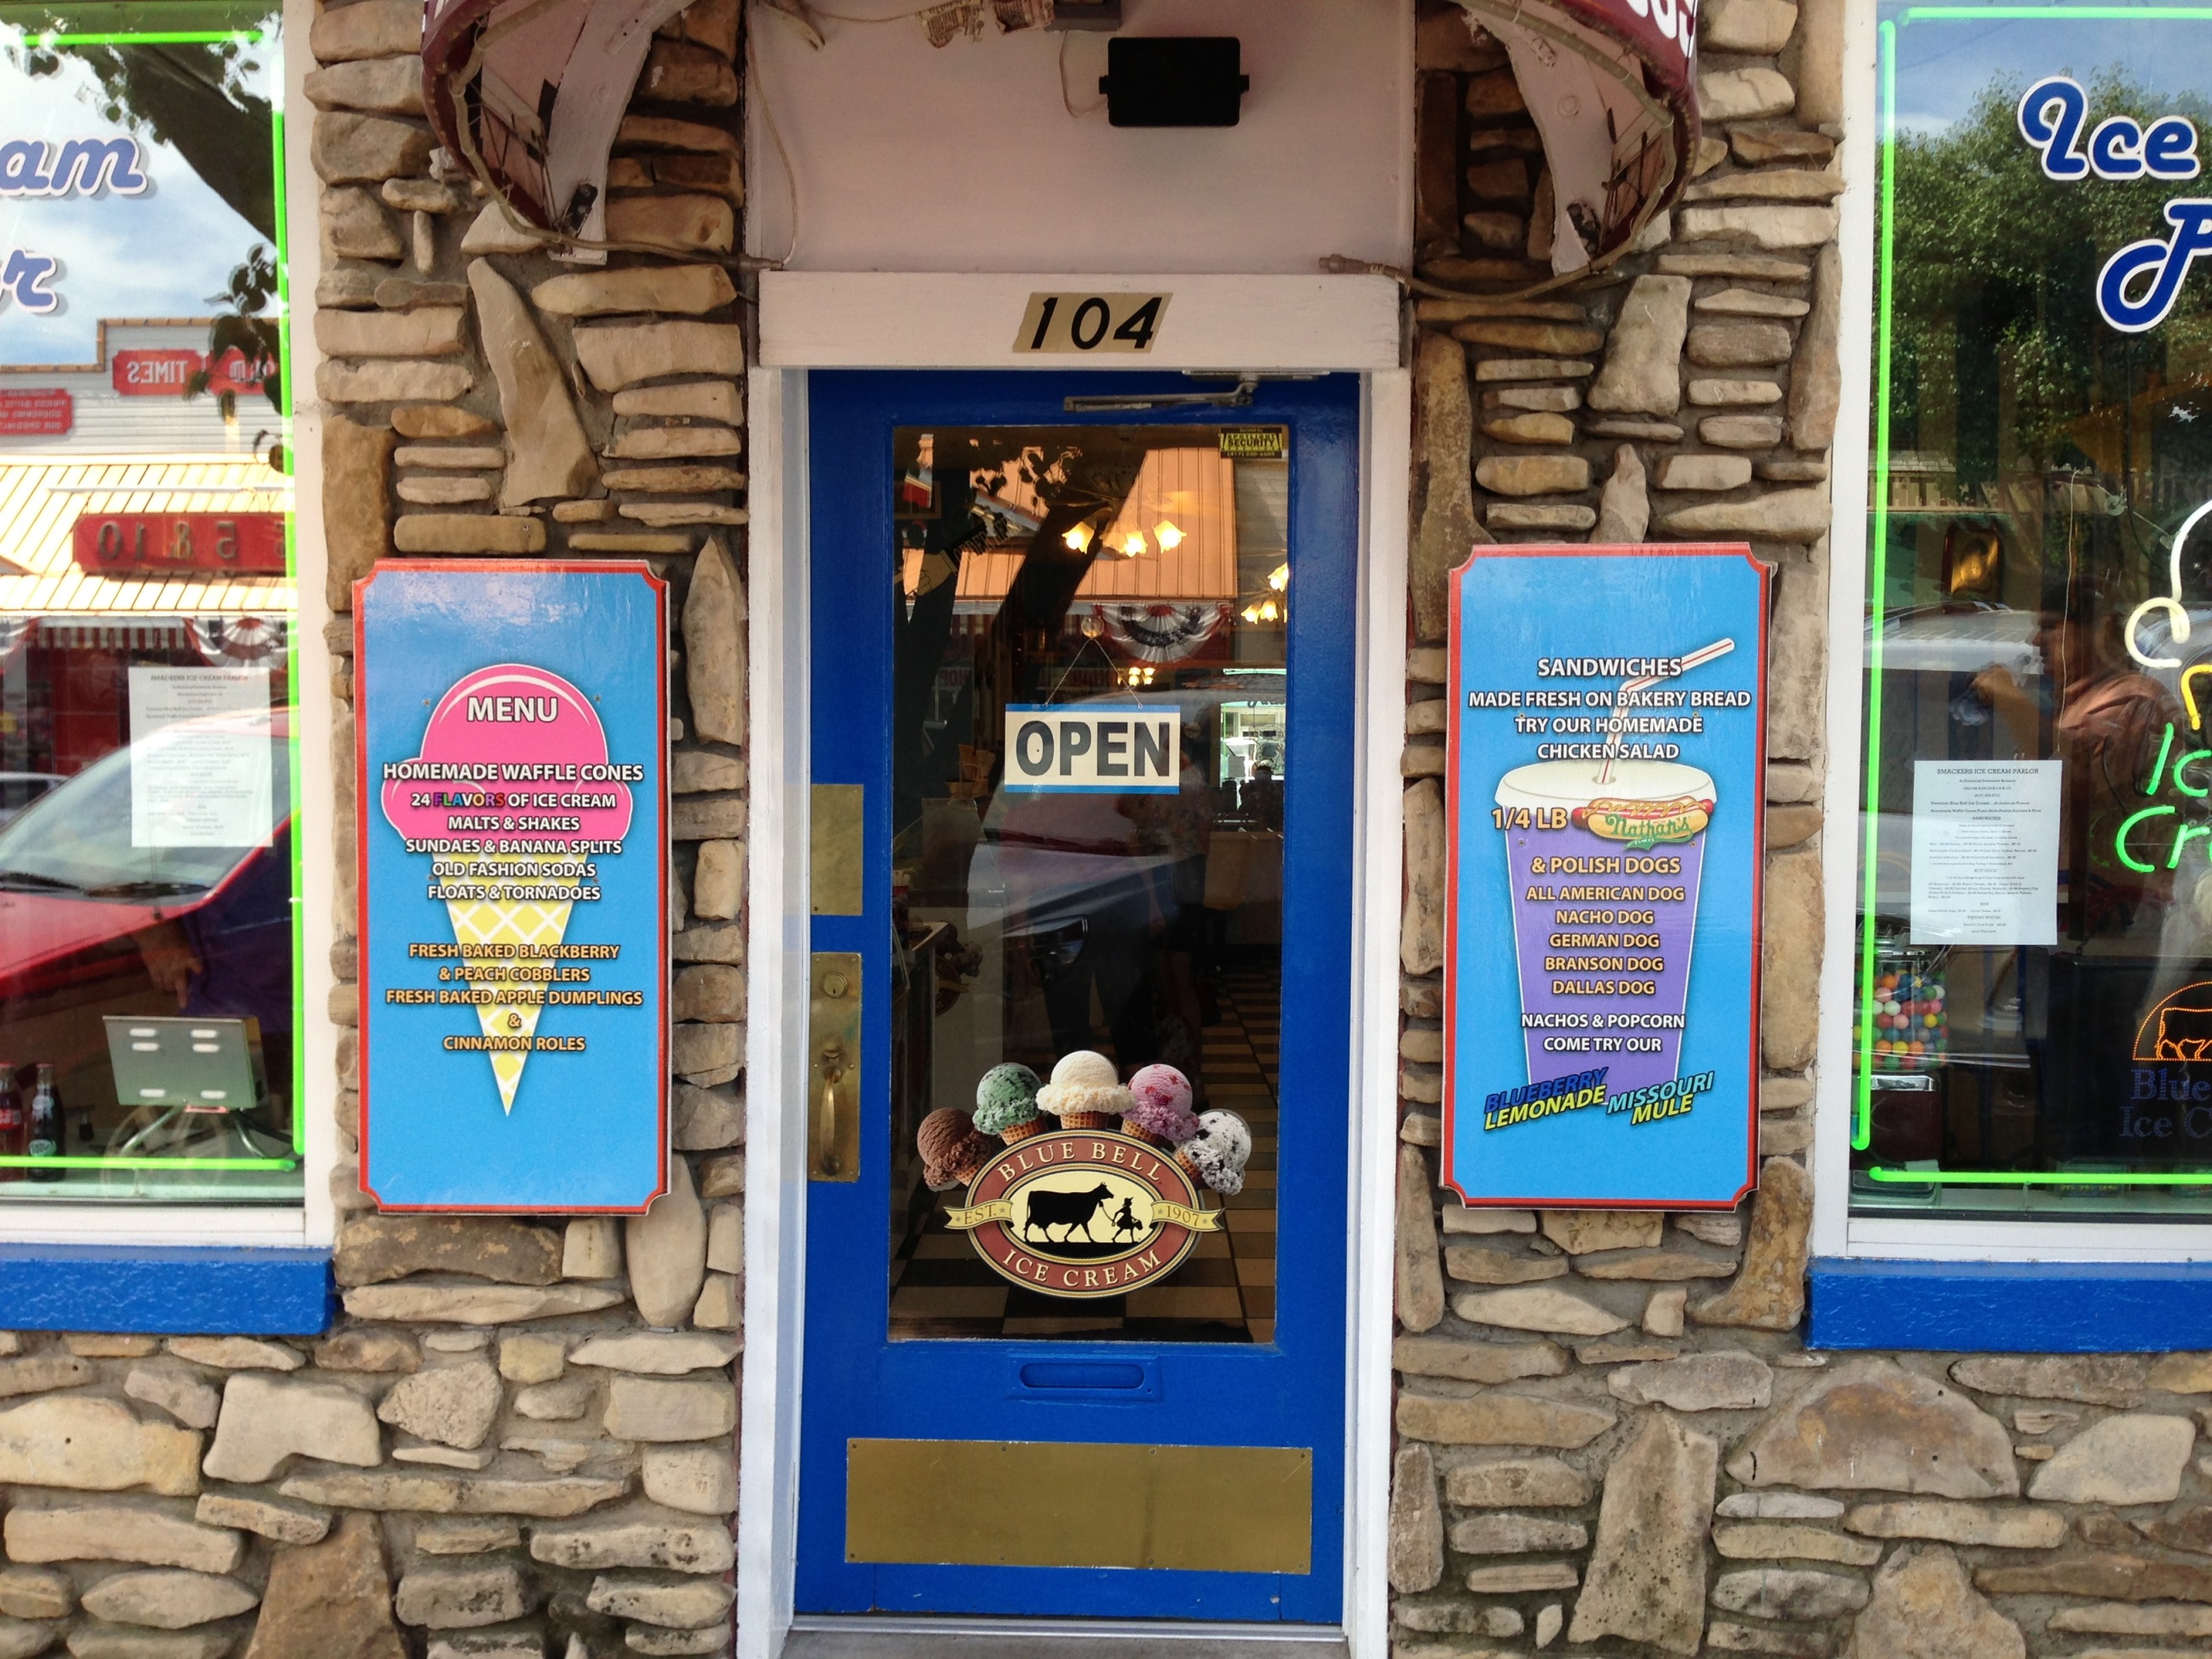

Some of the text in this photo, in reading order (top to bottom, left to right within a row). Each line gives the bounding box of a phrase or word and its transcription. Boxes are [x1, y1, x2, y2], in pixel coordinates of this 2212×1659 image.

[2017, 75, 2200, 180] Ice
[1030, 297, 1163, 351] 104
[1538, 657, 1683, 677] SANDWICHES
[1469, 691, 1751, 707] MADE FRESH ON BAKERY BREAD
[467, 696, 558, 723] MENU
[1515, 718, 1703, 733] TRY OUR HOMEMADE
[1016, 720, 1170, 777] OPEN
[1537, 744, 1679, 759] CHICKEN SALAD
[383, 763, 644, 781] HOMEMADE WAFFLE CONES
[411, 793, 616, 807] 24 FLAVORS OF ICE CREAM
[447, 816, 579, 831] MALTS & SHAKES
[1492, 807, 1567, 830] 1/4 LB
[1605, 813, 1691, 837] Nathan's
[406, 839, 622, 854] SUNDAES & BANANA SPLITS
[2115, 805, 2212, 873] Cr
[432, 862, 596, 877] OLD FASHION SODAS
[1531, 857, 1681, 874] & POLISH DOGS
[428, 885, 601, 901] FLOATS & TORNADOES
[1527, 886, 1684, 902] ALL AMERICAN DOG
[1555, 910, 1654, 924] NACHO DOG
[1550, 933, 1660, 948] GERMAN DOG
[409, 944, 620, 959] FRESH BAKED BLACKBERRY
[1544, 957, 1664, 971] BRANSON DOG
[439, 968, 590, 982] & PEACH COBBLERS
[1552, 980, 1655, 995] DALLAS DOG
[386, 990, 643, 1006] FRESH BAKED APPLE DUMPLINGS
[508, 1013, 522, 1028] &
[1522, 1013, 1685, 1029] NACHOS & POPCORN
[443, 1036, 585, 1051] CINNAMON ROLES
[1544, 1037, 1662, 1052] COME TRY OUR
[1484, 1067, 1609, 1114] BLUEBERRY
[1606, 1071, 1716, 1114] MISSOURI
[2131, 1068, 2210, 1101] Blue
[1483, 1085, 1607, 1131] LEMONADE
[1631, 1094, 1694, 1125] MULE
[2119, 1106, 2172, 1137] Ice
[997, 1141, 1161, 1182] BLUE BELL
[964, 1204, 1200, 1227] EST. 1907
[1001, 1249, 1161, 1288] ICE CREAM
